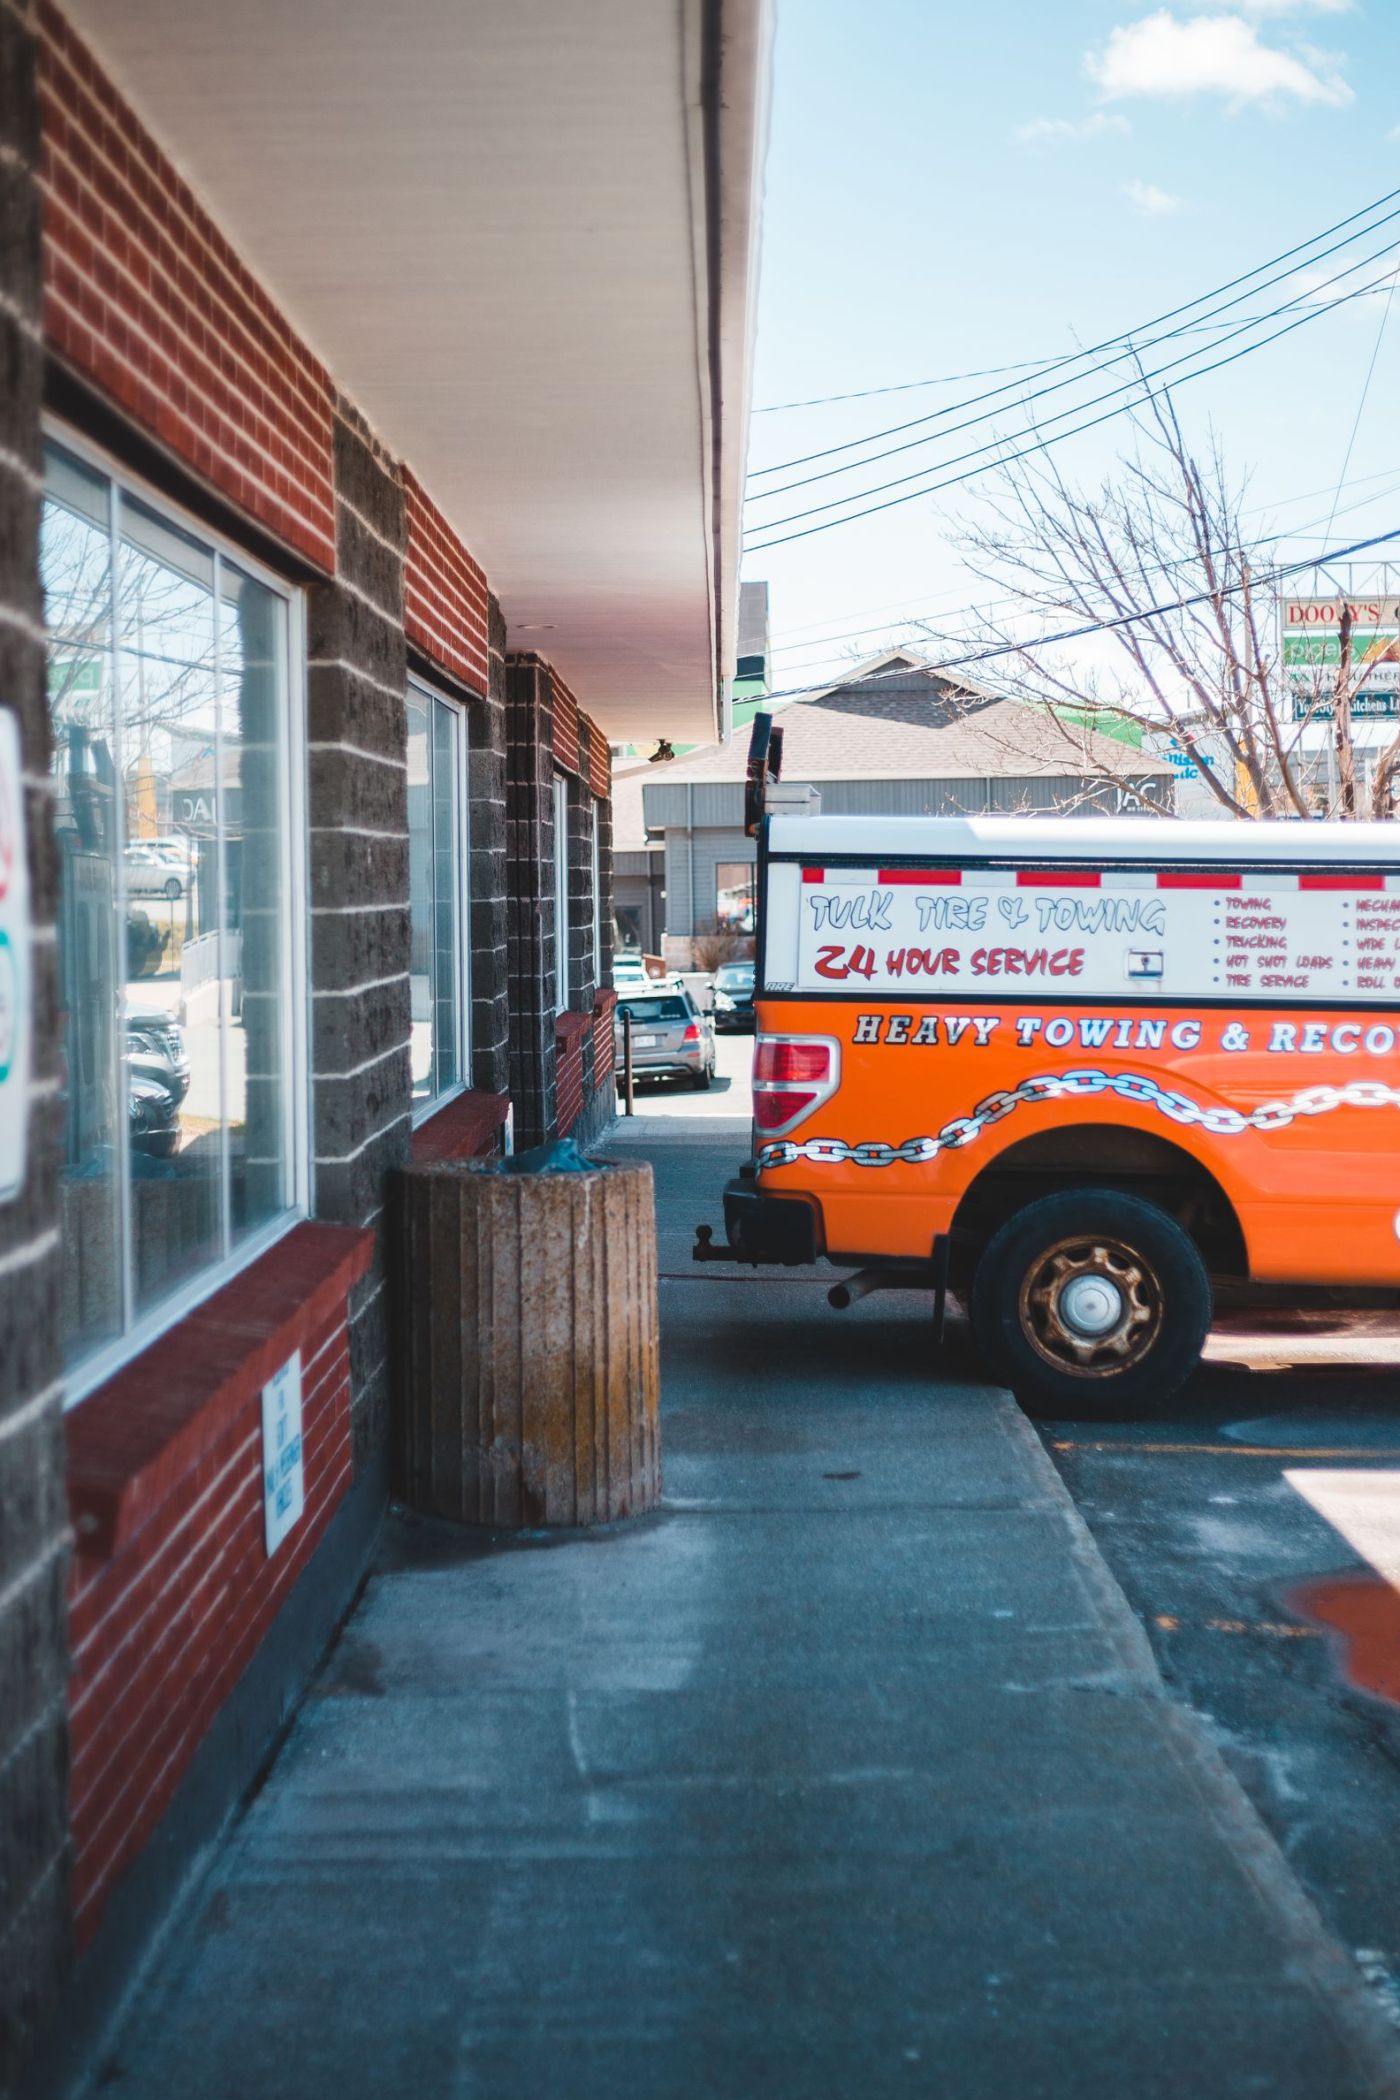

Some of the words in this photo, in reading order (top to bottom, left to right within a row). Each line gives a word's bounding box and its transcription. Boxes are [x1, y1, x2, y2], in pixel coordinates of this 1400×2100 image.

[1289, 604, 1380, 623] DOOY'S
[1225, 896, 1272, 911] TOWING
[810, 890, 894, 931] TULK
[915, 896, 989, 932] TIRE
[998, 896, 1029, 929] &
[1035, 897, 1167, 936] TOWING
[1225, 916, 1287, 931] RECOVERY
[1225, 934, 1287, 949] TRUCKING
[814, 944, 878, 981] 24
[886, 947, 960, 978] HOUR
[970, 947, 1085, 976] SERVICE
[1226, 954, 1249, 969] HOT
[1257, 954, 1288, 969] SHOT
[1296, 954, 1334, 970] LOADS
[1357, 956, 1396, 971] HEAVY
[1225, 973, 1252, 988] TIRE
[1260, 974, 1310, 988] SERVICE
[1357, 975, 1386, 989] ROLL
[852, 1015, 1000, 1046] HEAVY
[1016, 1016, 1201, 1050] TOWING
[1220, 1021, 1250, 1051] &
[1267, 1022, 1400, 1055] RECO
